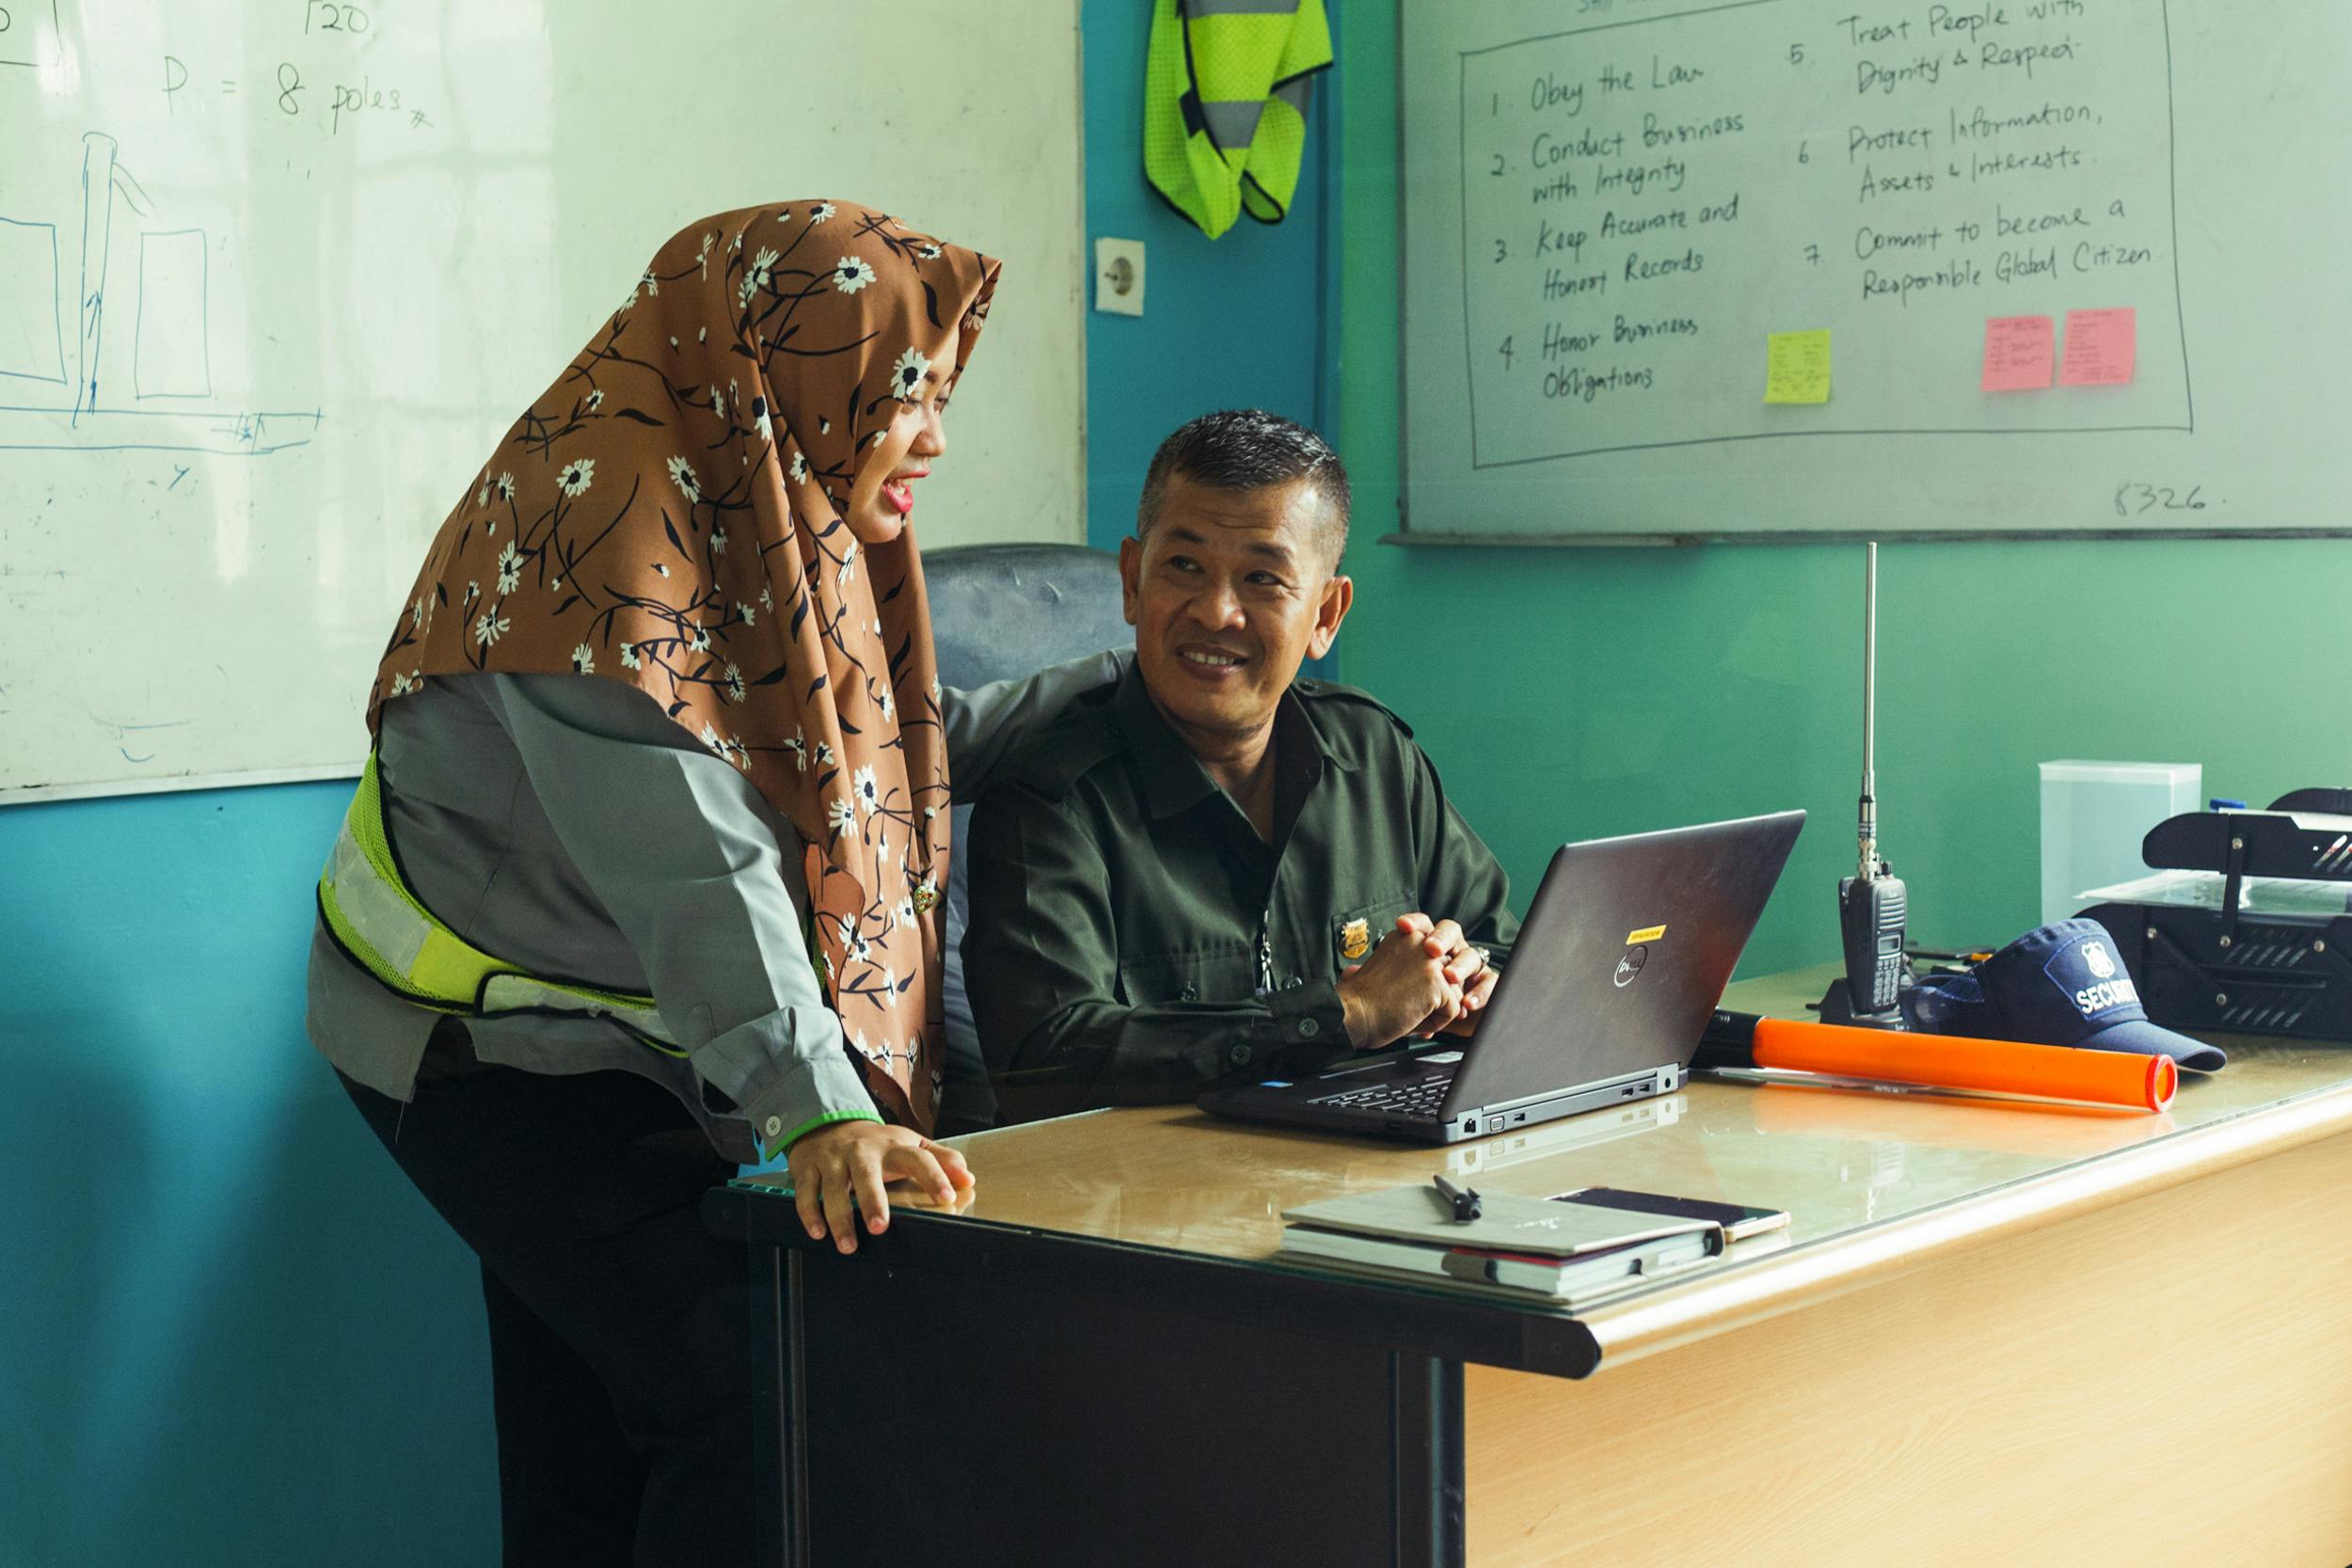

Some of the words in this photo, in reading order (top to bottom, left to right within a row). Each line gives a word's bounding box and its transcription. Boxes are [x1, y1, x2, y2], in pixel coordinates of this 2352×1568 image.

[1836, 14, 1911, 46] Treat
[1928, 3, 2009, 43] People
[2026, 0, 2084, 19] with
[278, 62, 306, 115] 8
[331, 75, 401, 135] poles
[1531, 72, 1583, 117] Obey
[1598, 64, 1634, 93] the
[1652, 55, 1704, 89] Law
[1857, 57, 1941, 95] Dignity
[1532, 127, 1625, 169] Conduct
[1643, 112, 1744, 149] Business
[1849, 125, 1931, 164] Protect
[1950, 103, 2102, 143] Information,
[1533, 172, 1578, 203] with
[1595, 157, 1685, 195] Integrity
[1859, 164, 1933, 203] Assets
[1535, 220, 1587, 262] Keep
[1600, 210, 1688, 238] Accurate
[1699, 193, 1739, 221] and
[1855, 226, 1943, 260] Commit
[1955, 221, 1979, 244] to
[1996, 203, 2091, 236] become
[2108, 198, 2125, 219] a
[1544, 269, 1608, 301] Honest
[1625, 248, 1704, 283] Records
[1863, 259, 1981, 308] Responsible
[1994, 247, 2058, 283] Global
[2073, 240, 2151, 273] Citizen
[1543, 323, 1601, 361] Honor
[1614, 314, 1698, 344] Business
[1544, 366, 1653, 403] Obligations
[2076, 979, 2139, 1014] SECURIT
